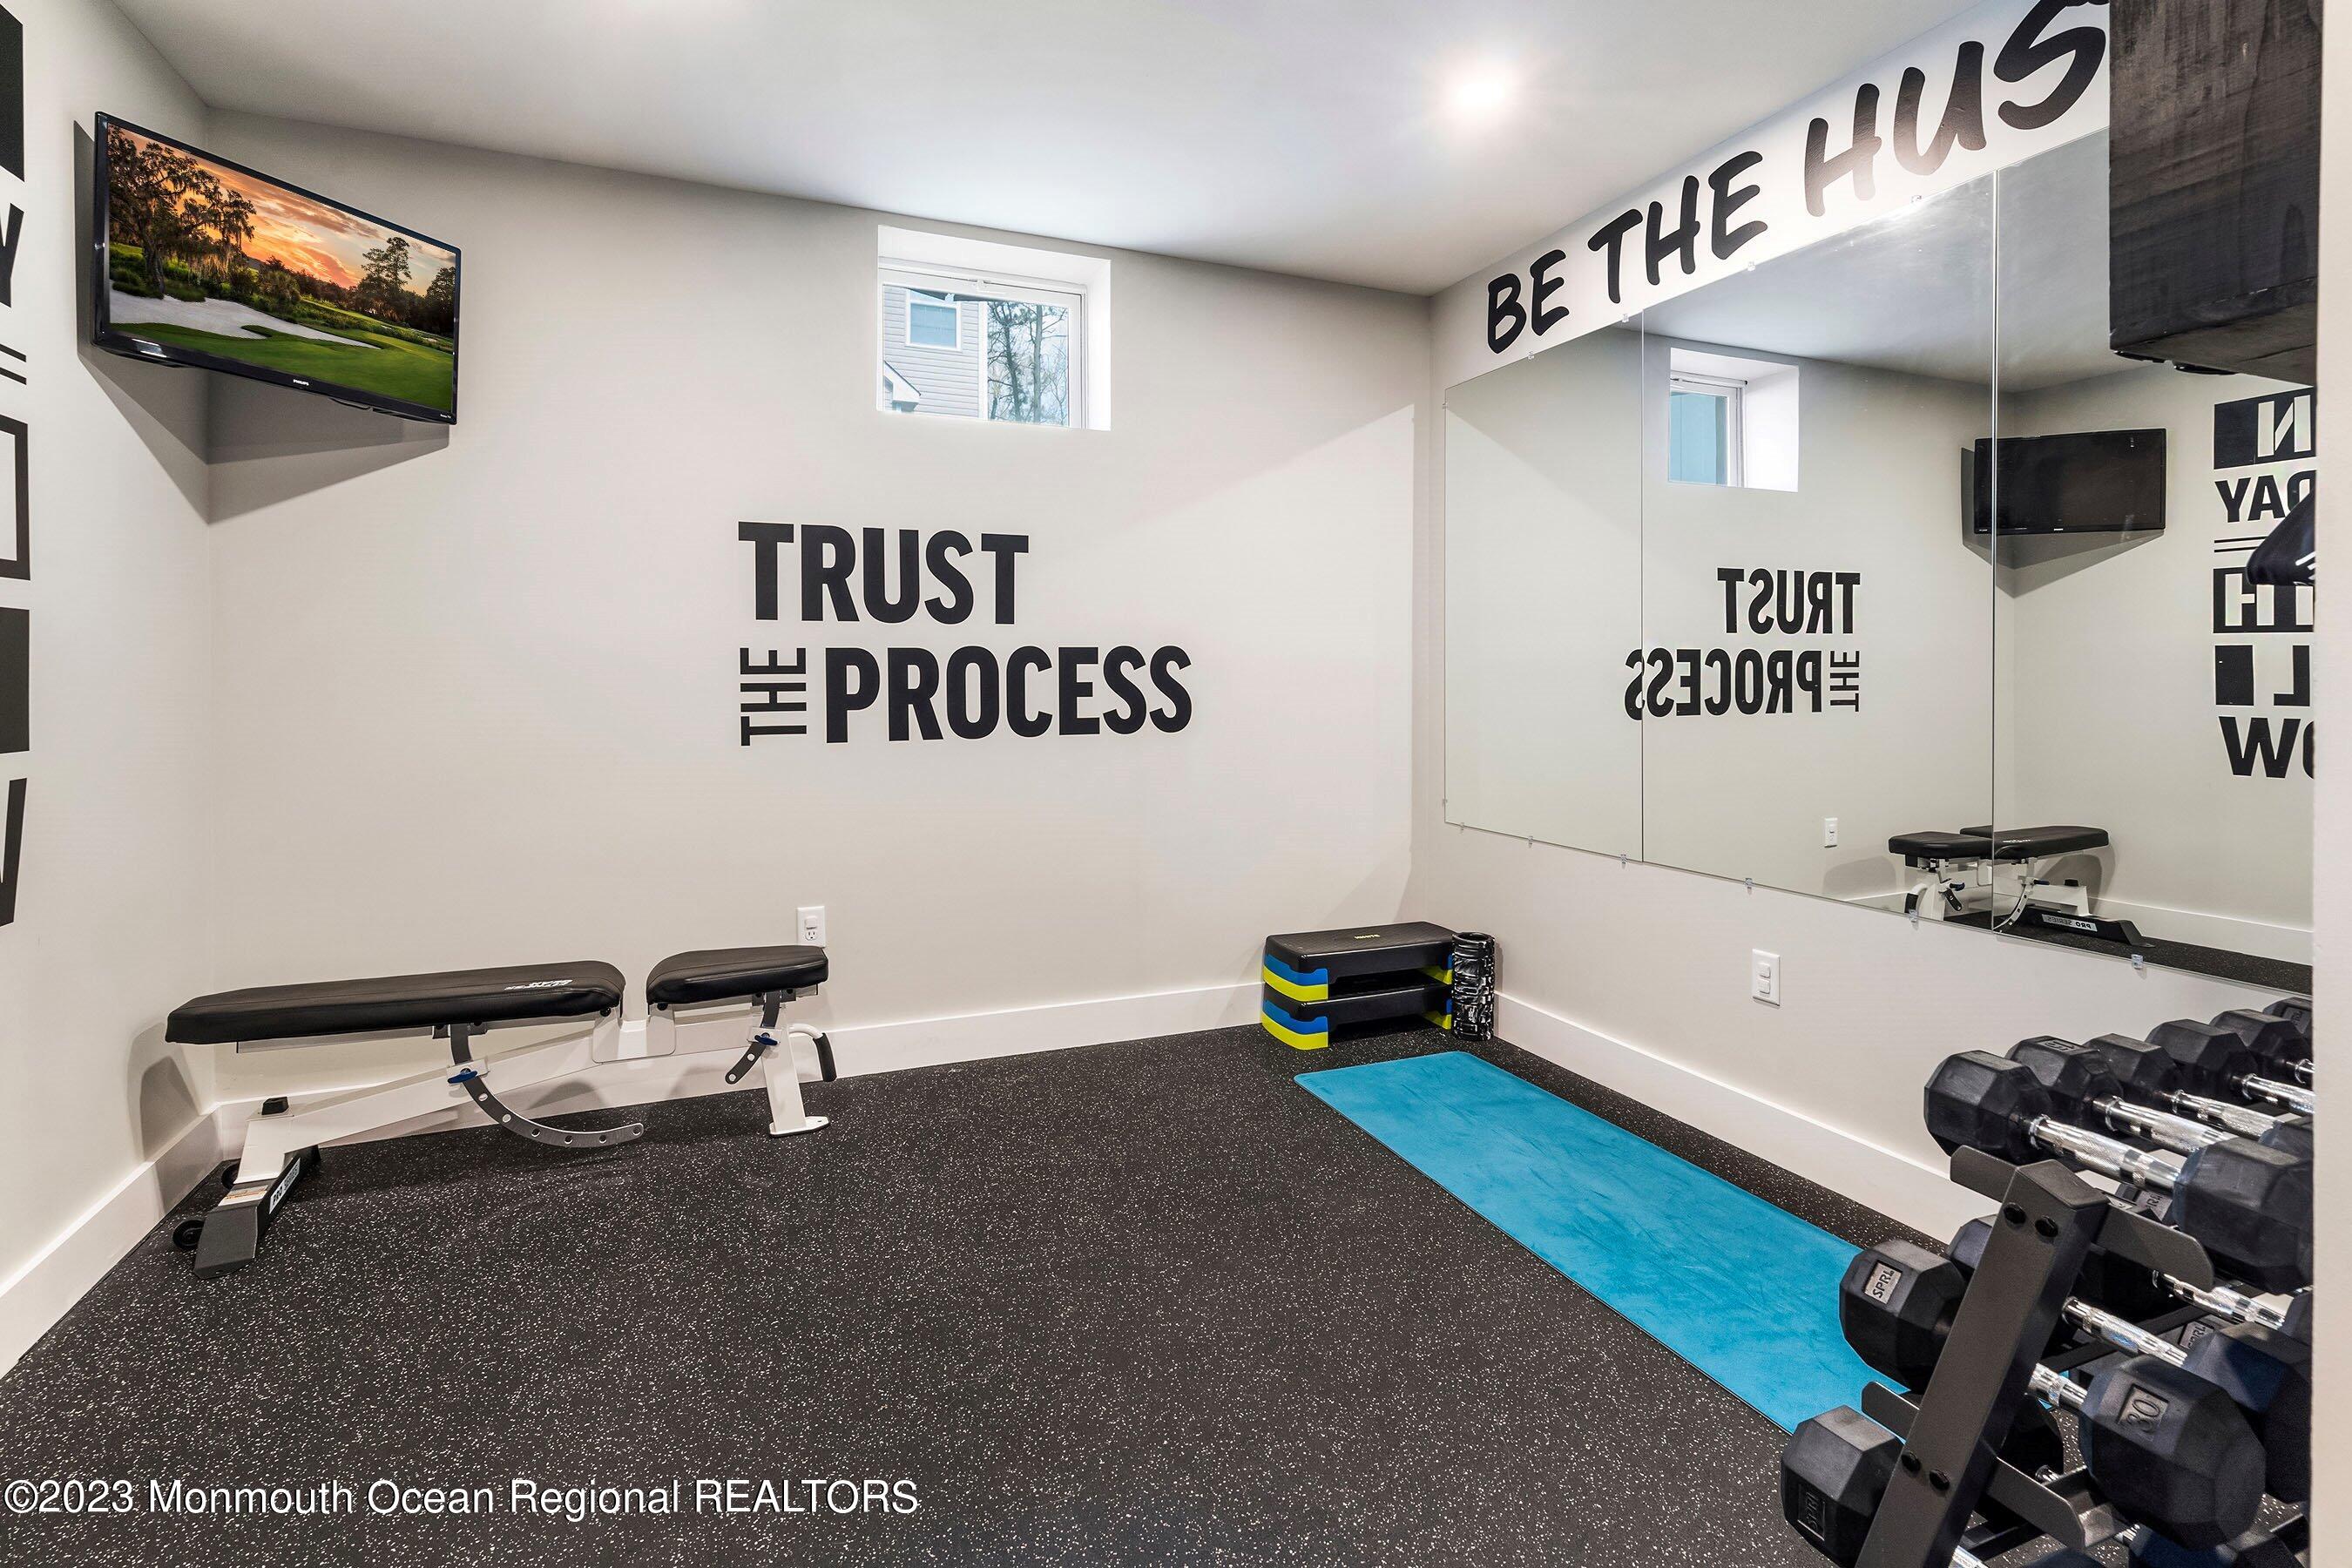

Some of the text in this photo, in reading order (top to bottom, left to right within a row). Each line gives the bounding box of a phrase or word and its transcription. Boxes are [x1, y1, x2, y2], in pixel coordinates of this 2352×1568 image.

[1487, 249, 1569, 354] BE
[1587, 151, 1768, 304] THE
[739, 521, 1030, 625] TRUST
[740, 645, 1193, 747] THE PROCESS
[2126, 1399, 2160, 1437] 30
